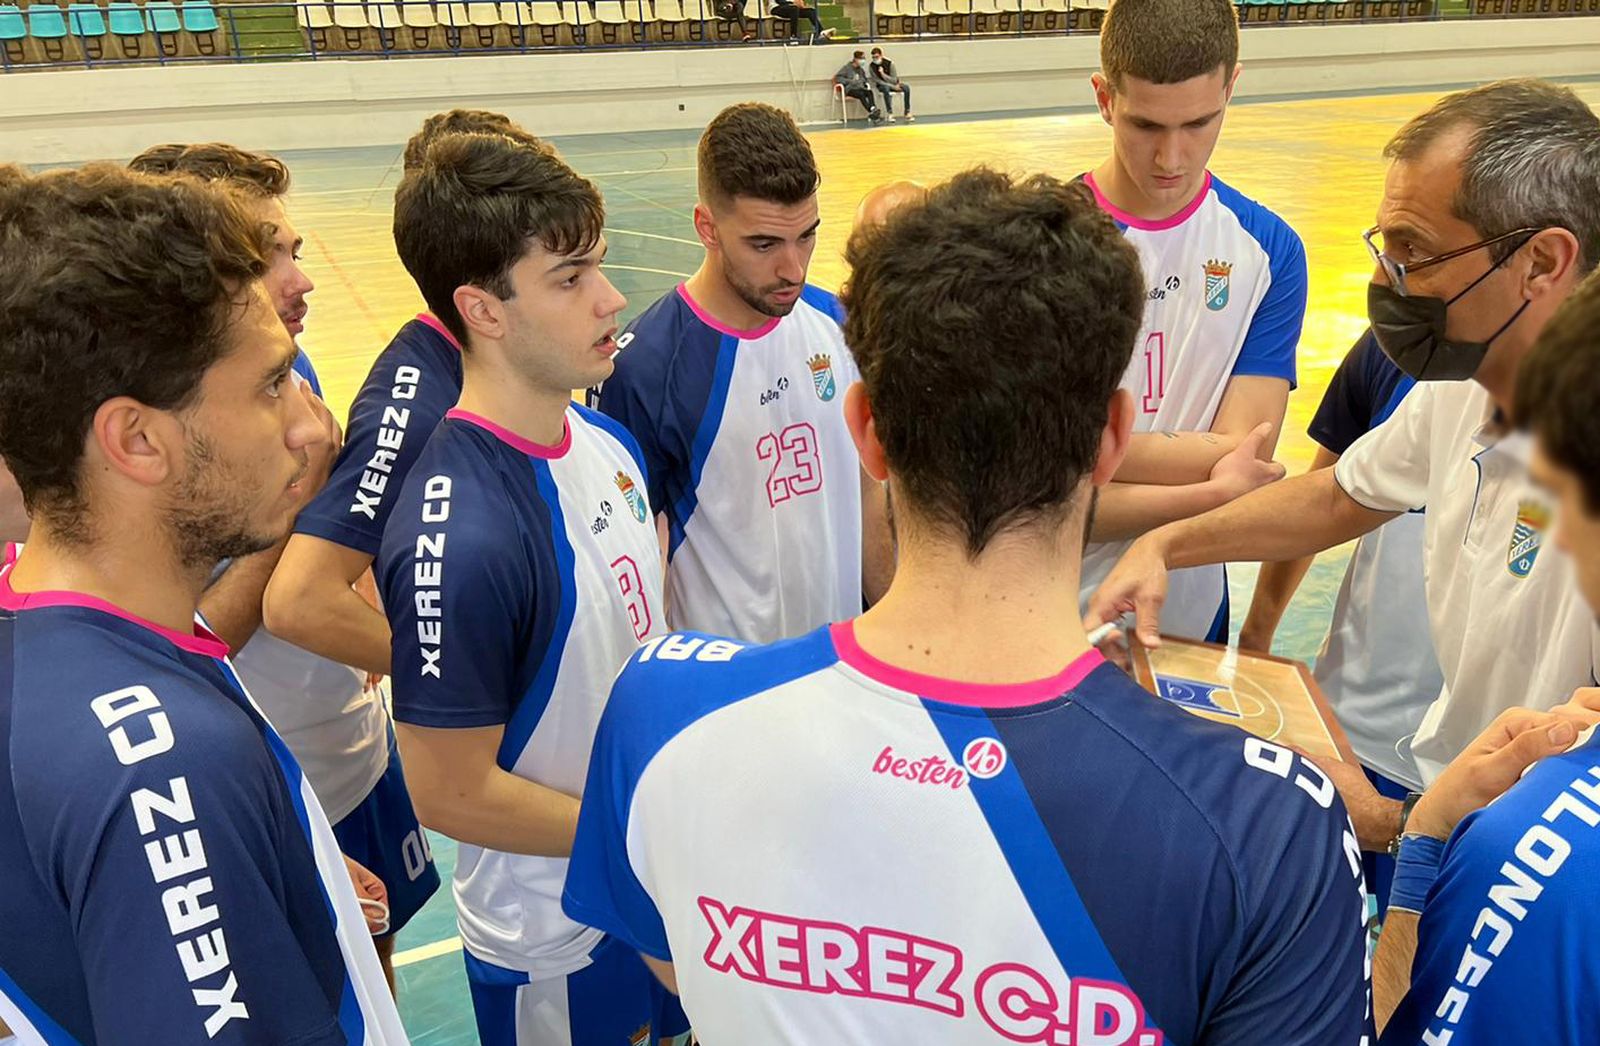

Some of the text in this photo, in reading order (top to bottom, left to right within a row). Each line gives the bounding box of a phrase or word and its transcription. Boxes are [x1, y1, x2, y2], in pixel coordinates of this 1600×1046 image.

[350, 365, 421, 520] XEREZ CD
[756, 422, 823, 509] 23
[414, 475, 452, 679] XEREZ CD
[872, 745, 966, 790] besten
[1243, 737, 1336, 809] CD
[90, 685, 250, 1039] XEREZ CD
[697, 895, 1165, 1046] XEREZ C.D.
